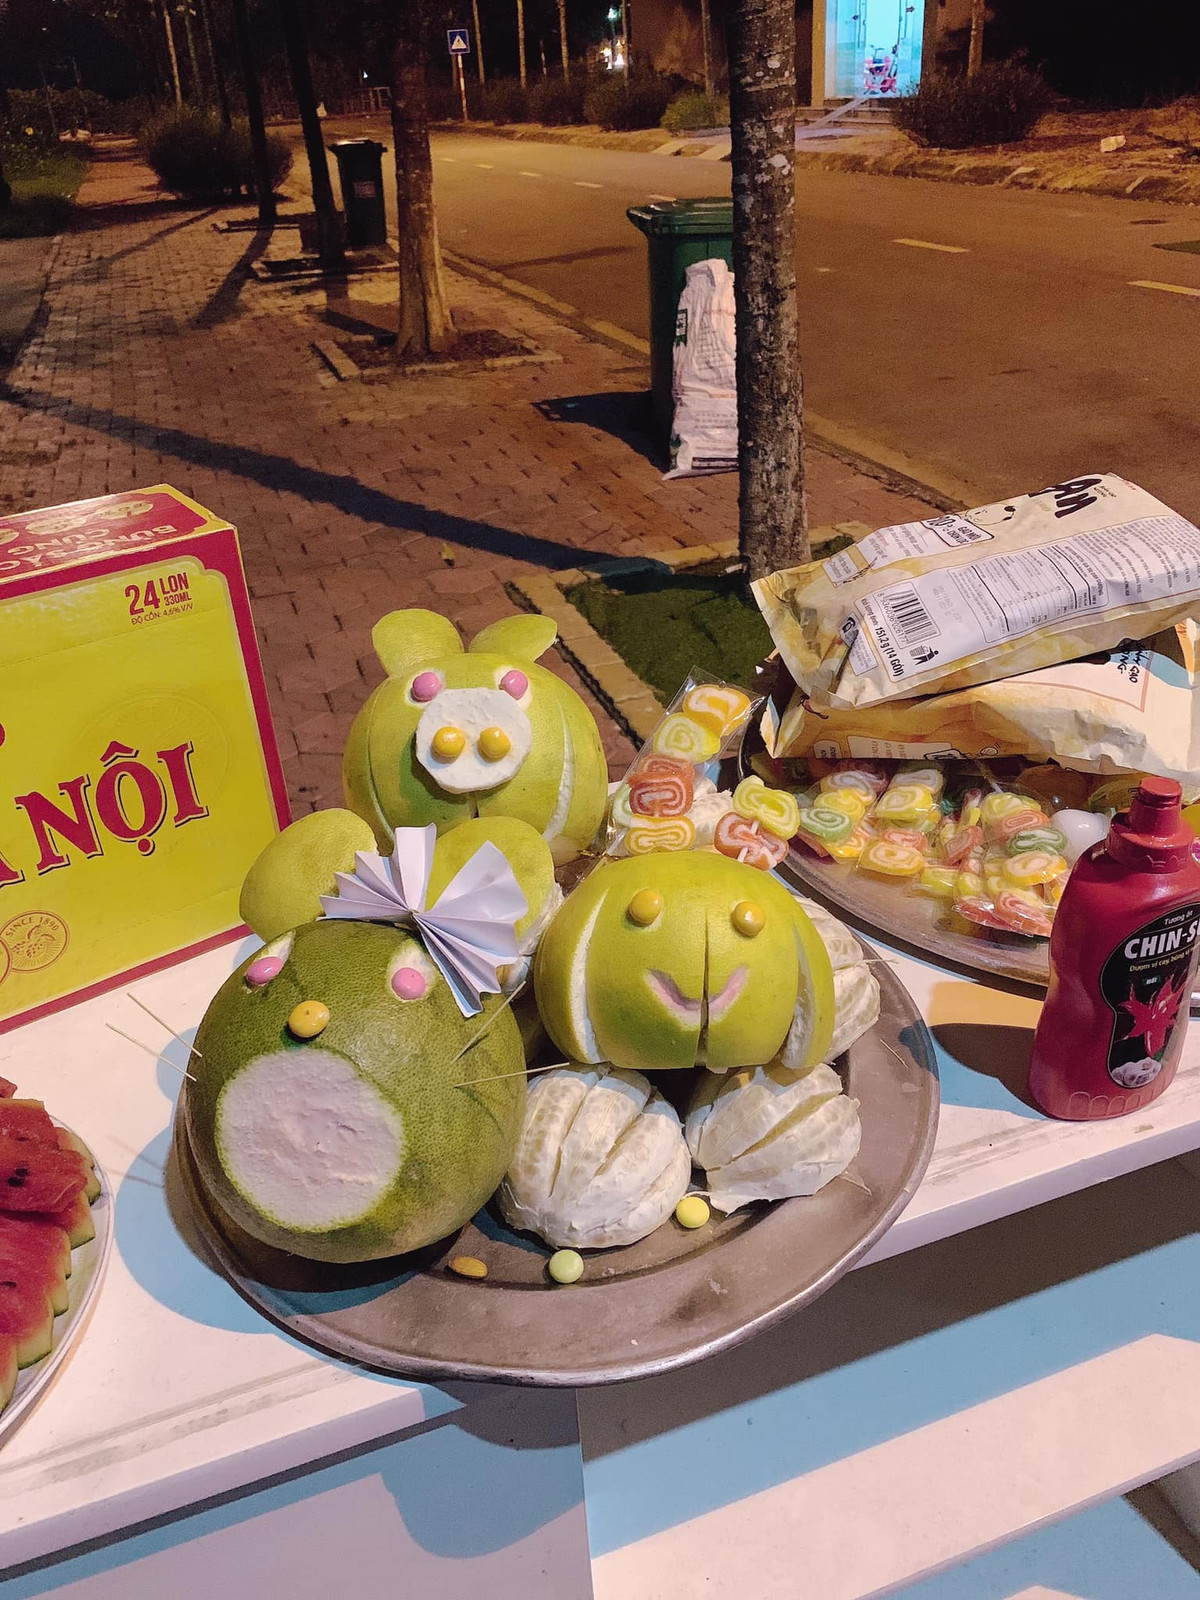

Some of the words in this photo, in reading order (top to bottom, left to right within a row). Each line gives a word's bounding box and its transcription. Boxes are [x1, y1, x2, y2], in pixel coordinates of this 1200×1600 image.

[124, 580, 160, 615] 24
[159, 572, 189, 595] LON
[163, 591, 192, 606] 330ML
[874, 626, 890, 644] 151,2
[883, 647, 897, 659] (14
[889, 658, 905, 678] GÓI)
[14, 740, 209, 875] NỘI
[5, 916, 35, 937] SINCE
[39, 916, 60, 931] 1890
[1124, 919, 1200, 959] CHIN-S
